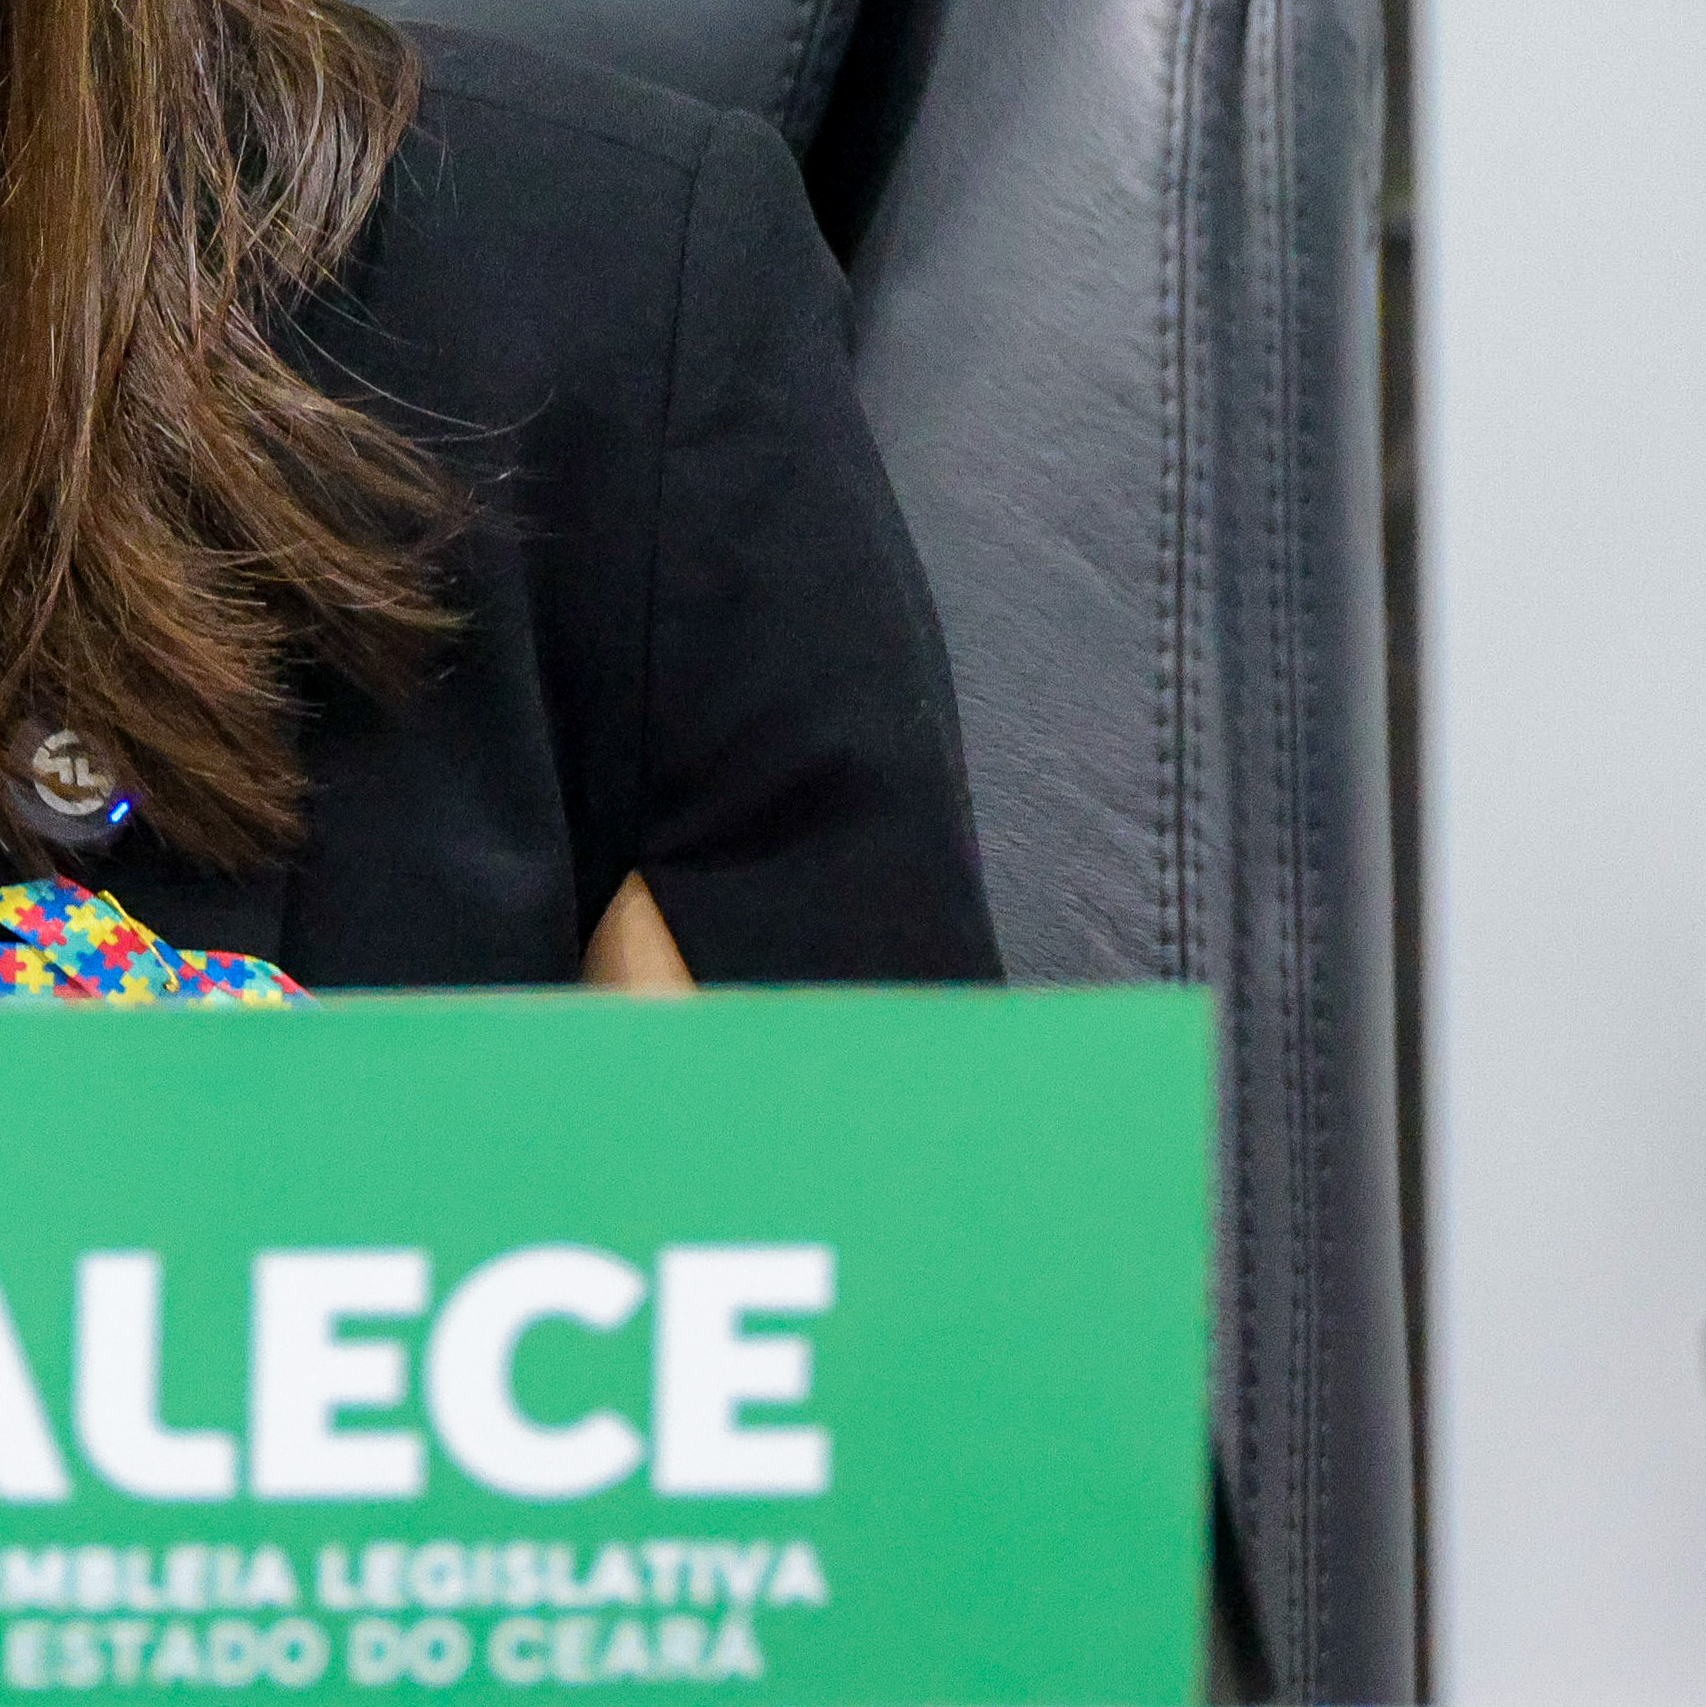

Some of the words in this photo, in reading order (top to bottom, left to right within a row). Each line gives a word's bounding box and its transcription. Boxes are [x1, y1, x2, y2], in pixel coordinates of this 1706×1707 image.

[317, 1540, 826, 1608] LEGISLATIVA
[3, 1617, 329, 1688] ESTADO
[348, 1616, 473, 1687] DO
[489, 1598, 764, 1684] CEARÁ
